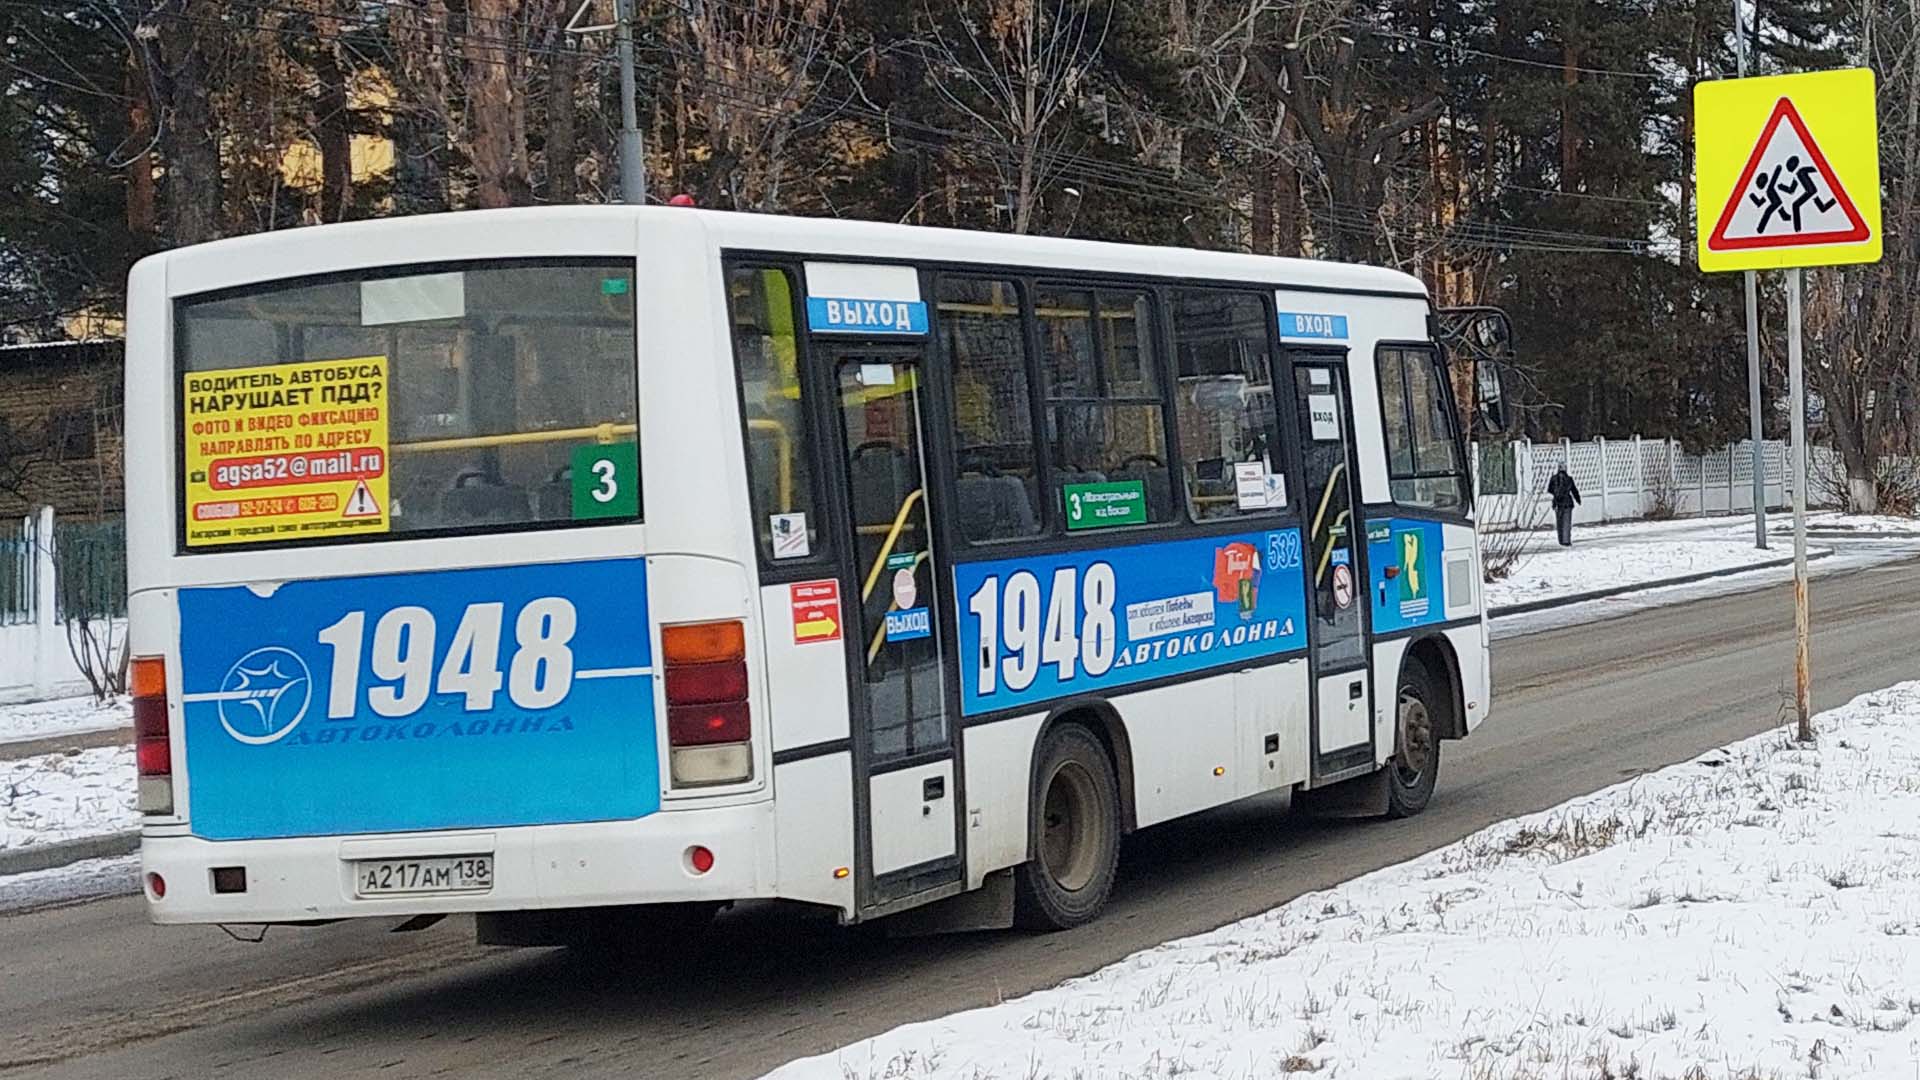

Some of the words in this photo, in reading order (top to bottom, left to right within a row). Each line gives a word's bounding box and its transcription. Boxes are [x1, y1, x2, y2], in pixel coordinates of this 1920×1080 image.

[827, 300, 911, 330] ВЫХОД
[1295, 315, 1333, 336] ВХОД
[189, 373, 284, 393] ВОДИТЕЛЬ
[289, 364, 382, 385] АВТОБУСА
[190, 388, 314, 414] НАРУШАЕТ
[321, 382, 382, 405] ПДД?
[193, 419, 230, 435] ФОТО
[235, 418, 244, 432] И
[248, 414, 293, 432] ВИДЕО
[298, 407, 379, 427] ФИКСАЦИЮ
[1313, 412, 1334, 424] ВХОД
[200, 436, 289, 455] НАПРАВЛЯТЬ
[295, 433, 312, 449] ПО
[317, 429, 372, 447] АДРЕСУ
[217, 453, 381, 486] agsa52@mail.ru
[592, 459, 617, 503] 3
[1070, 493, 1081, 520] 3
[1268, 532, 1300, 570] 532
[886, 612, 930, 634] ВЫХОД
[970, 562, 1116, 695] 1948
[318, 597, 577, 719] 1948
[1114, 618, 1295, 669] АВТОКОЛОННА
[286, 716, 575, 747] АВТОКОЛОННА
[366, 863, 450, 889] А217АМ
[454, 860, 487, 879] 138
